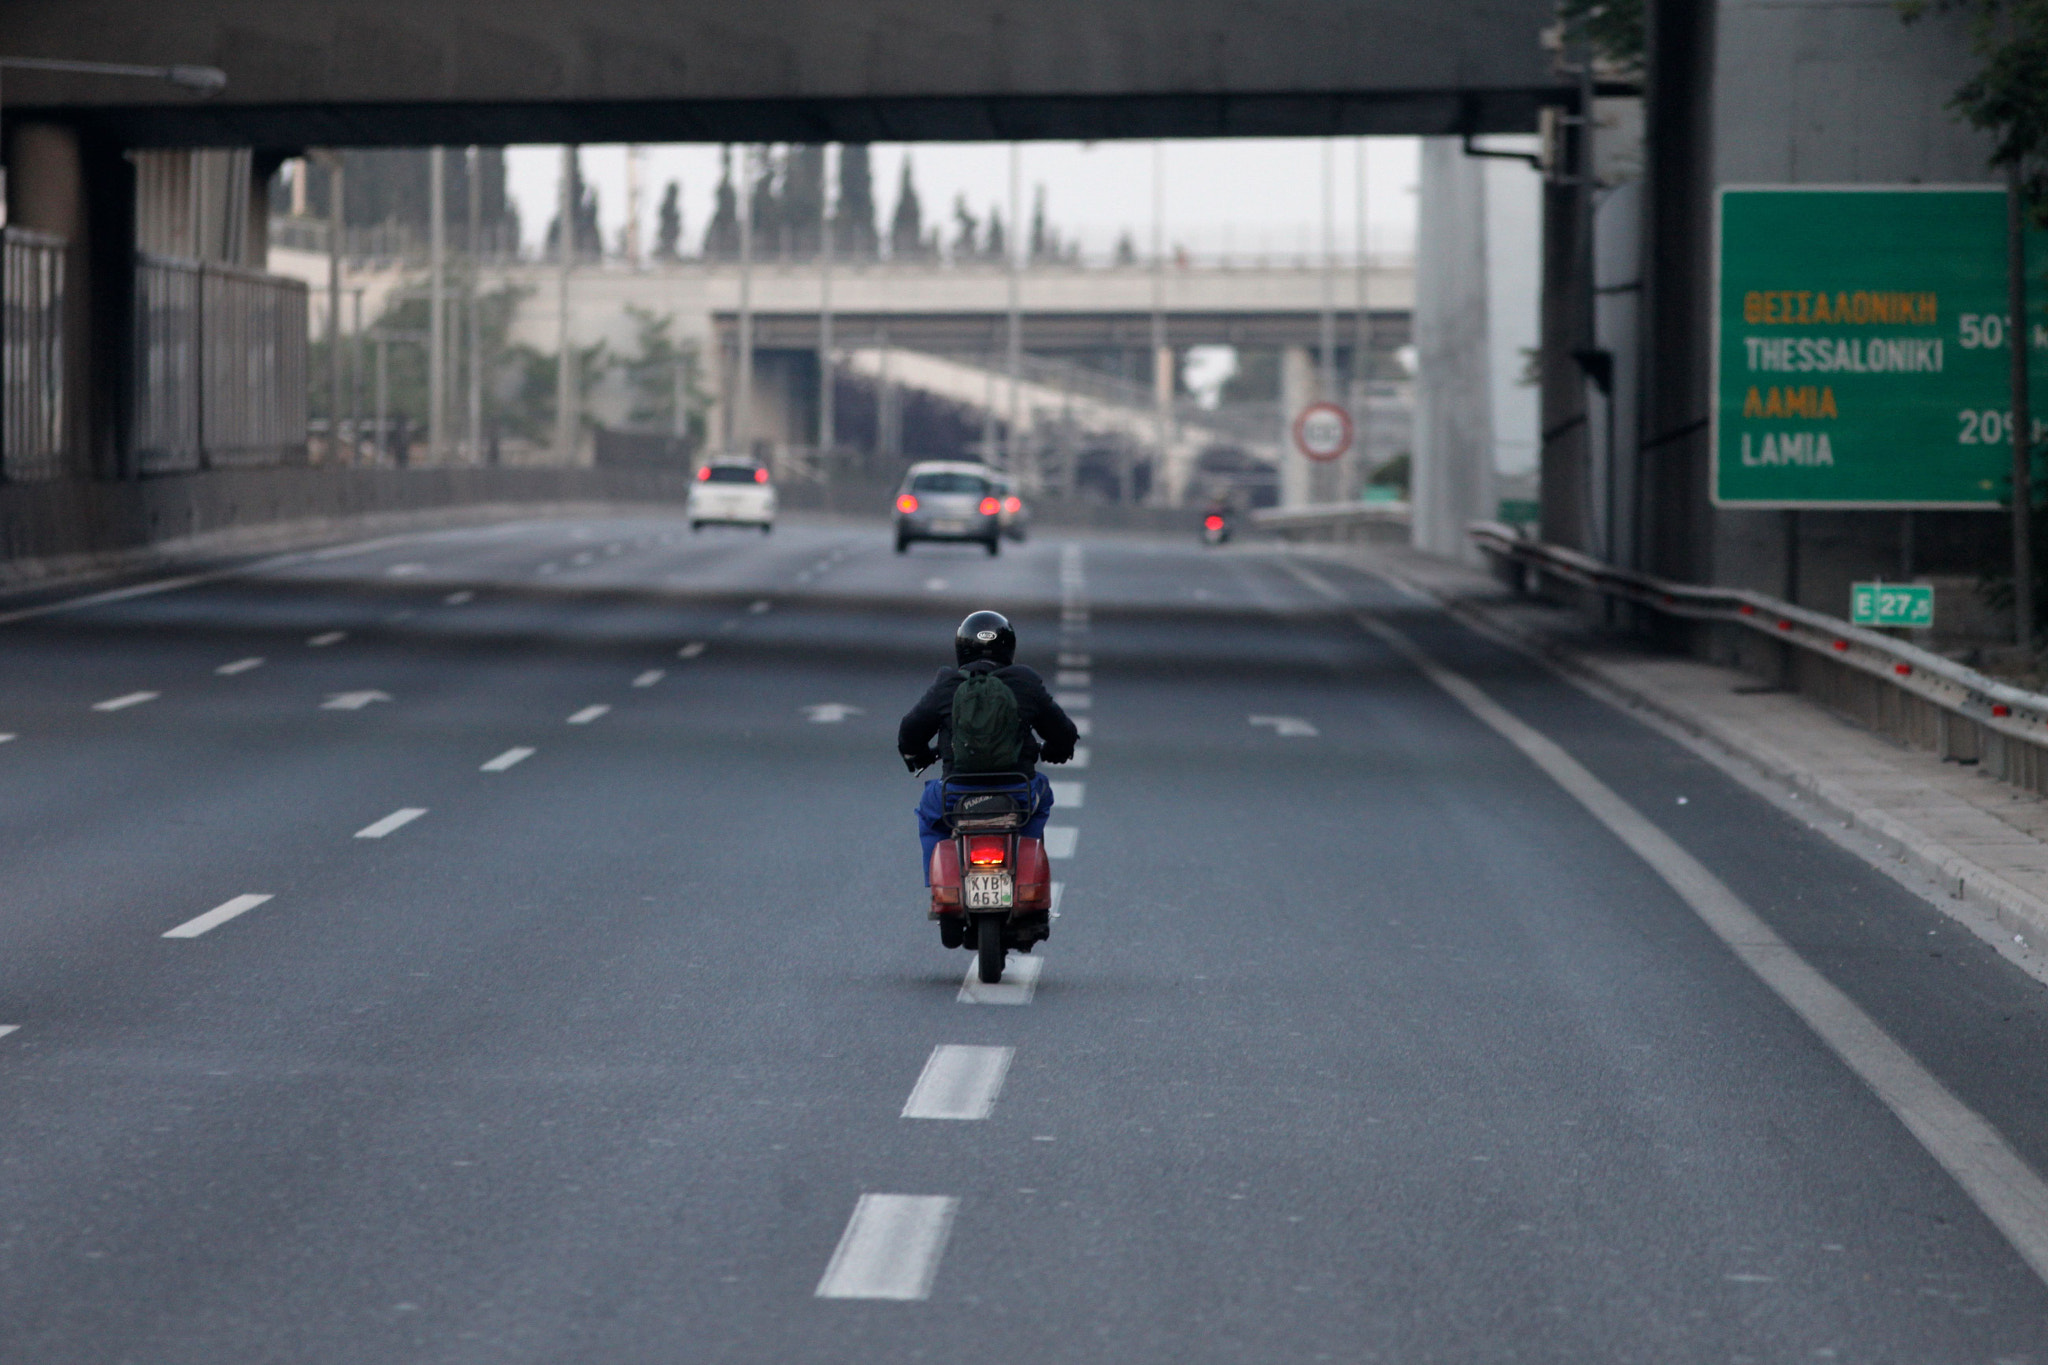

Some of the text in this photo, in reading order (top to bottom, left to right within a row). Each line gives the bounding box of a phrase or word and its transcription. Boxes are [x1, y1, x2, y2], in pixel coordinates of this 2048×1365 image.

[1744, 291, 1938, 324] ΘΕΣΣΑΛΟΝΙΚΗ
[1958, 314, 2013, 349] 50
[1744, 337, 1943, 372] THESSALONIKI
[1743, 386, 1838, 419] ΛΑΜΙΑ
[1741, 432, 1834, 466] LAMIA
[1857, 593, 1872, 616] E
[972, 891, 999, 905] 463
